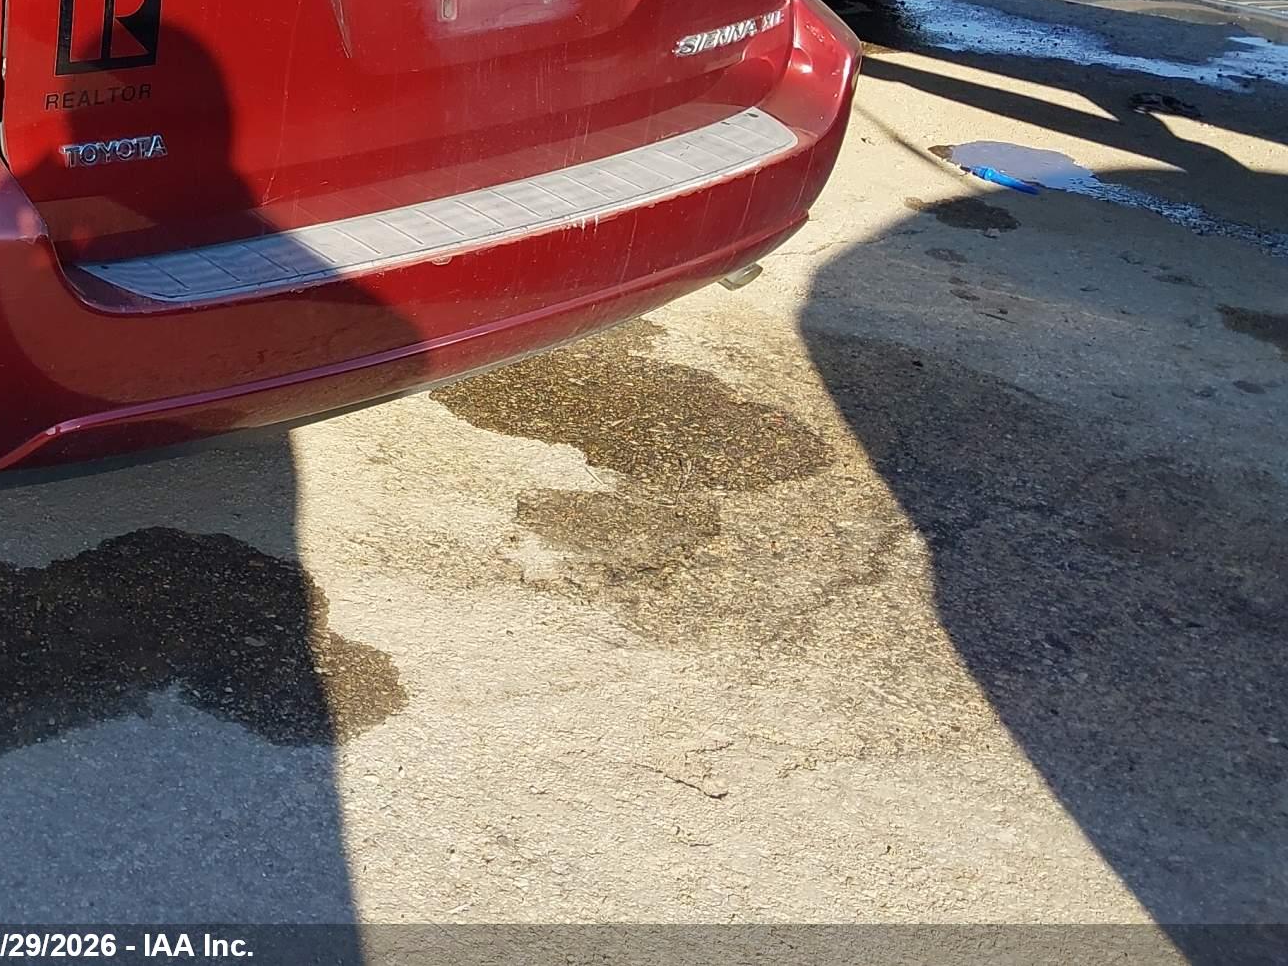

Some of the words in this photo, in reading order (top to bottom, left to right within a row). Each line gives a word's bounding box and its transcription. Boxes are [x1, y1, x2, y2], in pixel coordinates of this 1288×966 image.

[672, 18, 758, 57] SIENNA
[45, 84, 152, 111] REALTOR
[60, 134, 168, 169] TOYOTA
